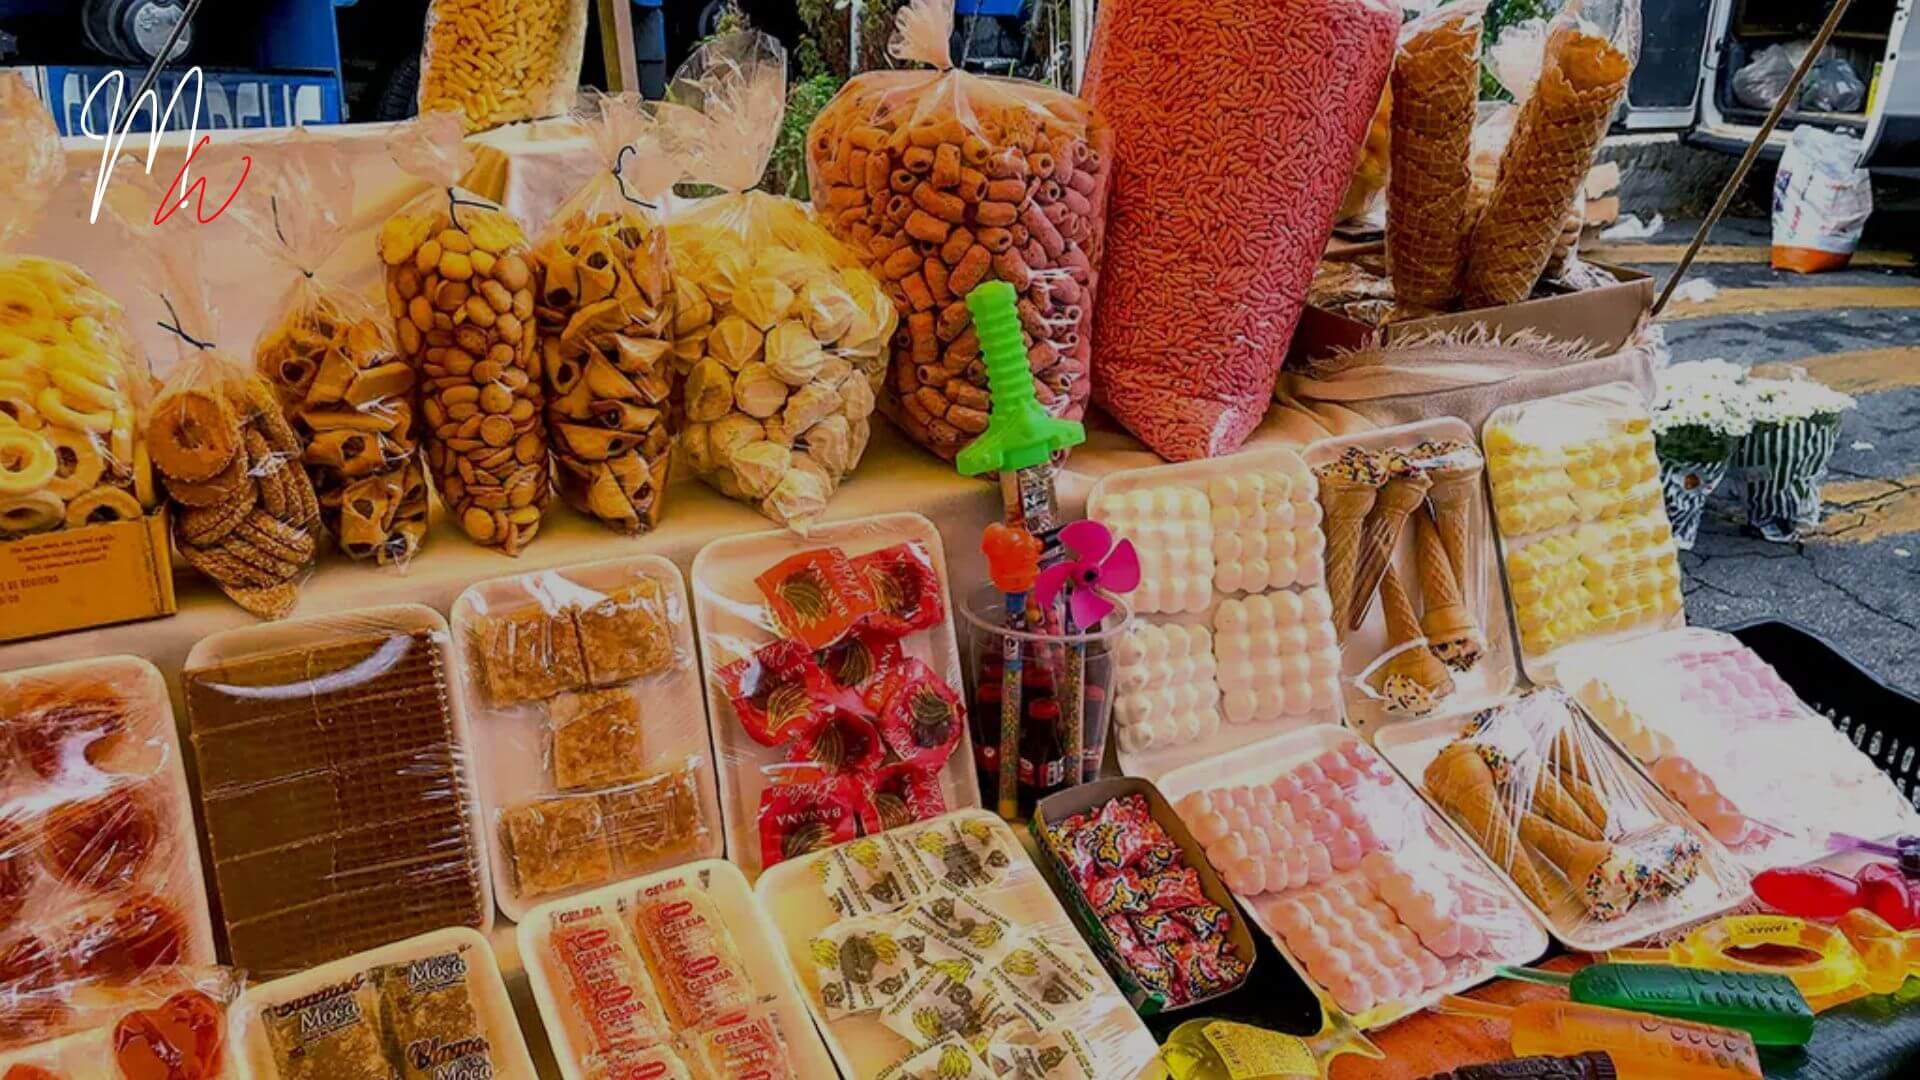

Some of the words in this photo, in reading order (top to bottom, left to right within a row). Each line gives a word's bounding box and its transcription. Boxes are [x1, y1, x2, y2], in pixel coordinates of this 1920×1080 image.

[775, 806, 842, 826] BANANA
[645, 877, 685, 896] GELEIA
[559, 905, 602, 924] GELEIA
[663, 915, 705, 934] GELEIA
[689, 969, 734, 991] GELEIA
[300, 1003, 361, 1034] Moça
[599, 1000, 646, 1021] GELEIA
[714, 1023, 761, 1045] GELEIA
